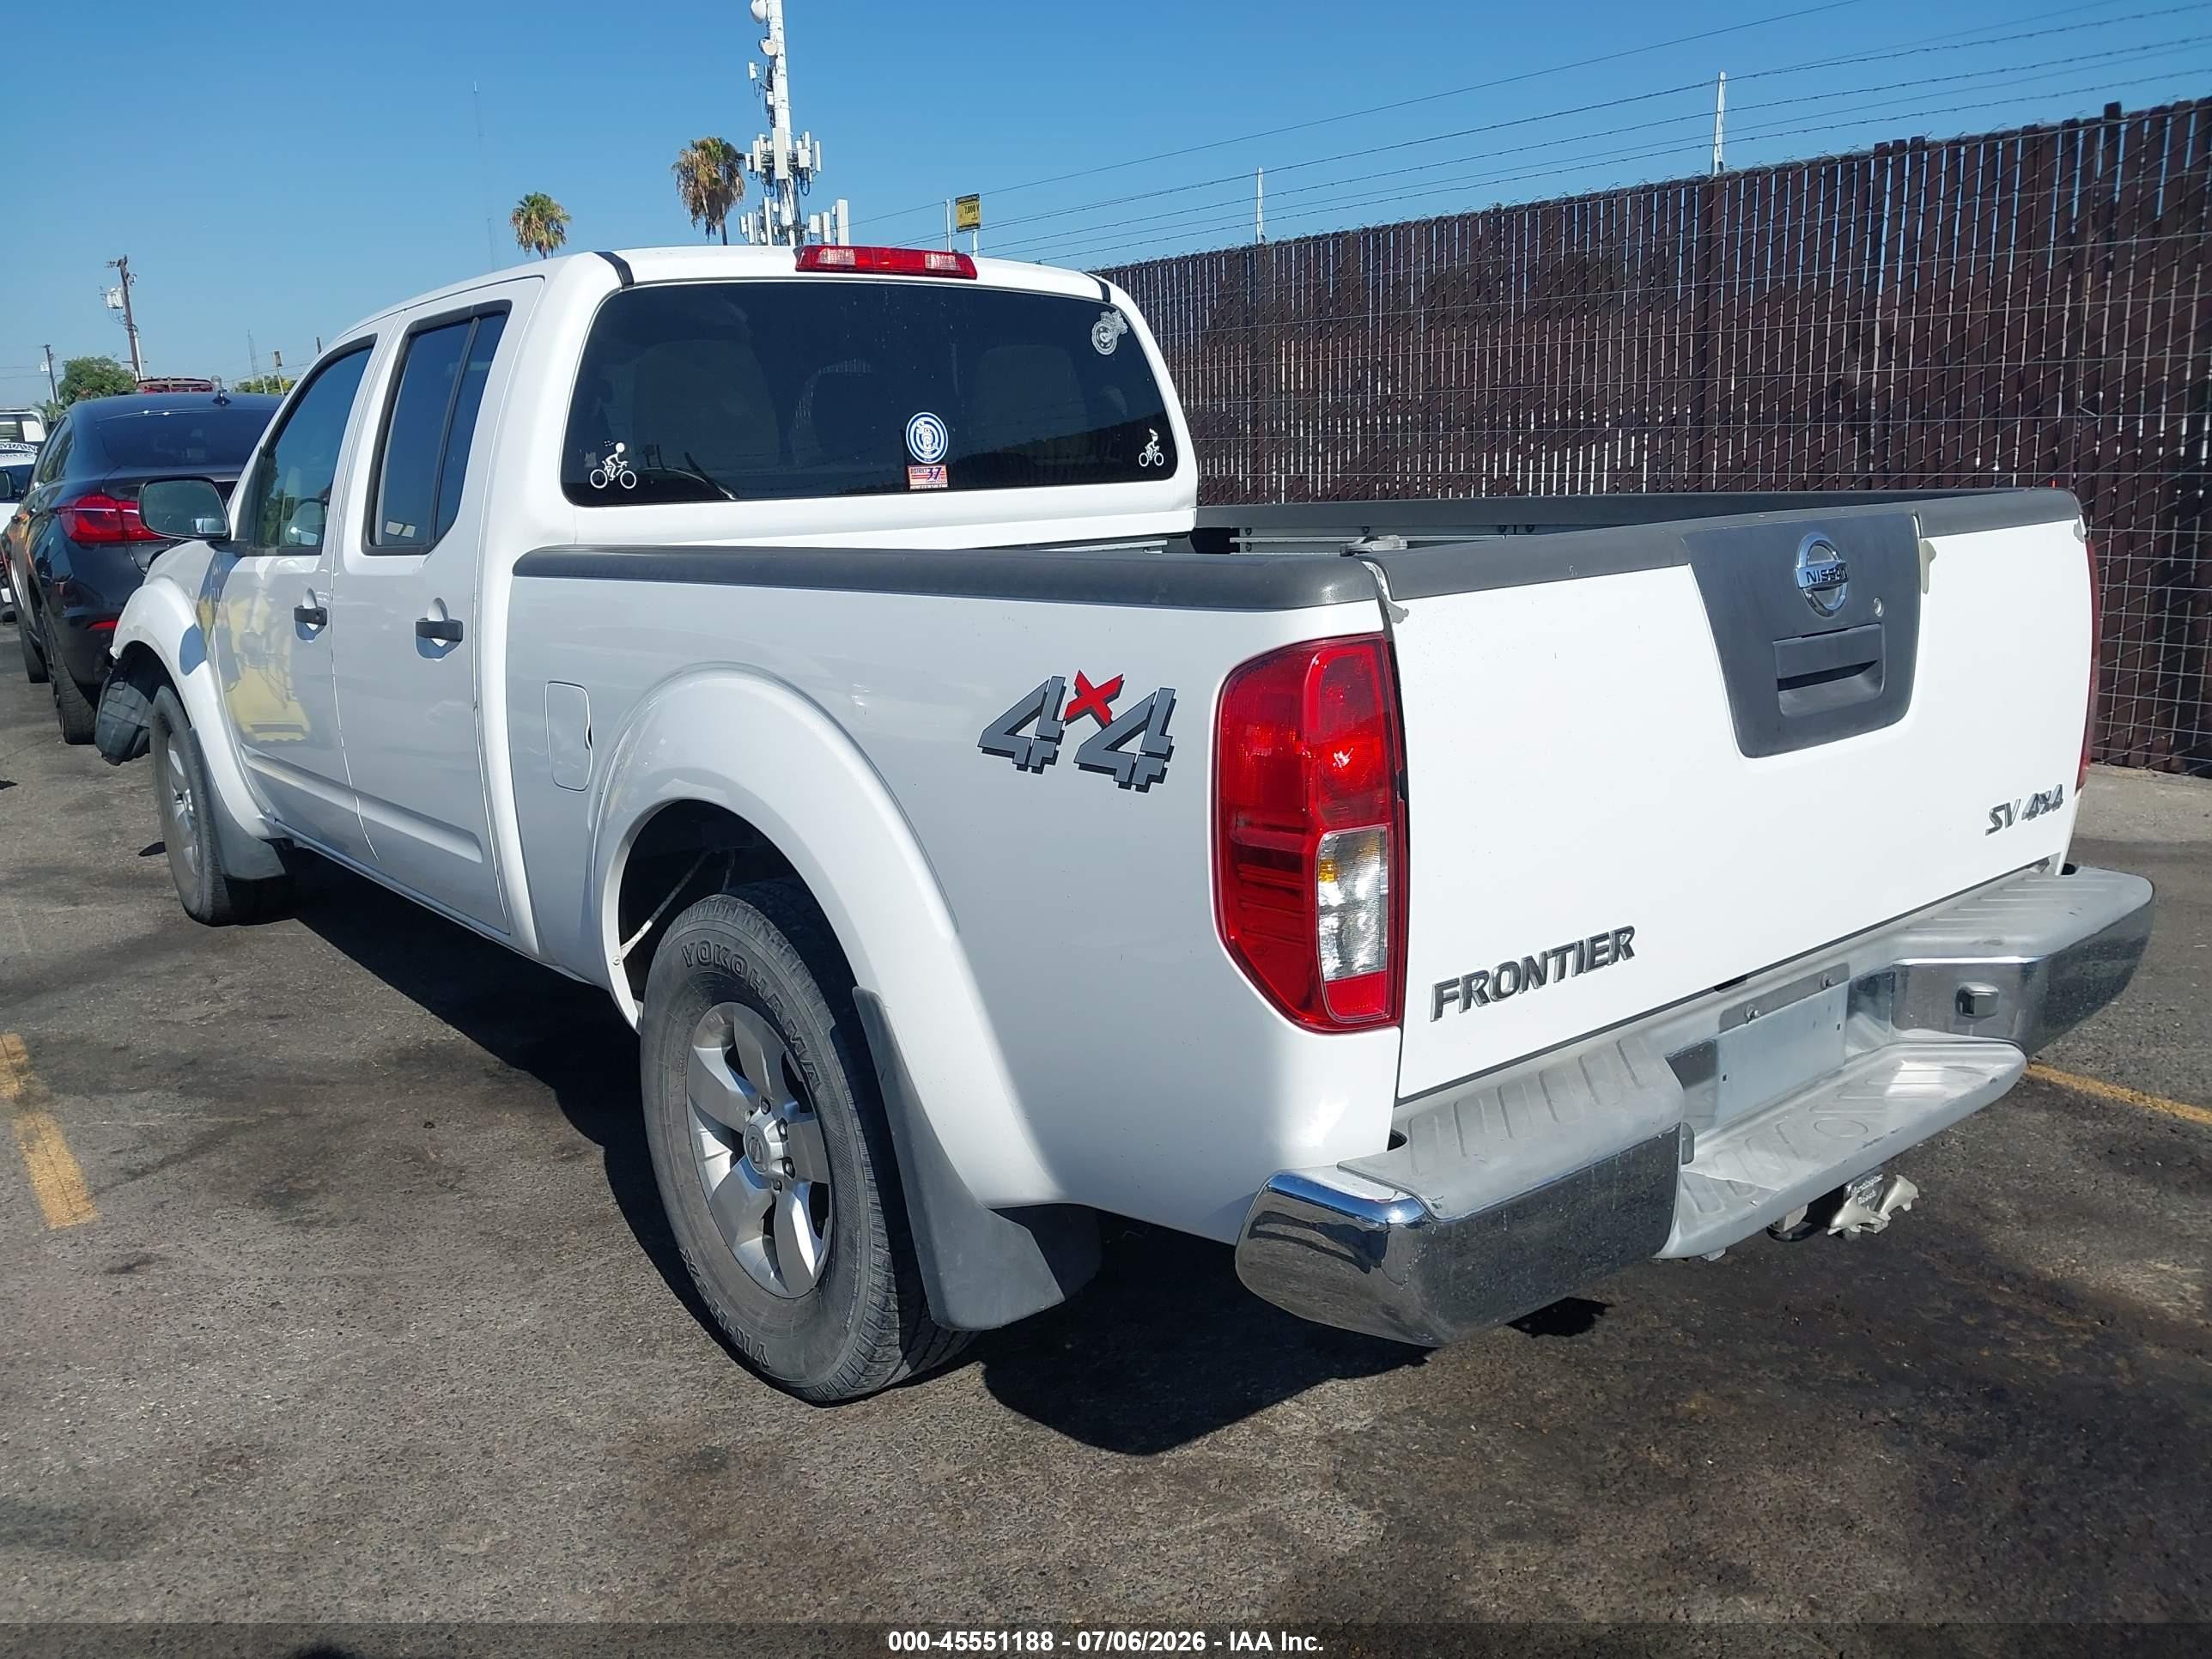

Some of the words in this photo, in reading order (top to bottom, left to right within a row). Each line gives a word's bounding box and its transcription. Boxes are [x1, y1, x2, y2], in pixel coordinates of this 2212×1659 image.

[1985, 799, 2021, 836] SV
[682, 939, 822, 1093] YOKOHAMA
[1430, 925, 1635, 1022] FRONTIER
